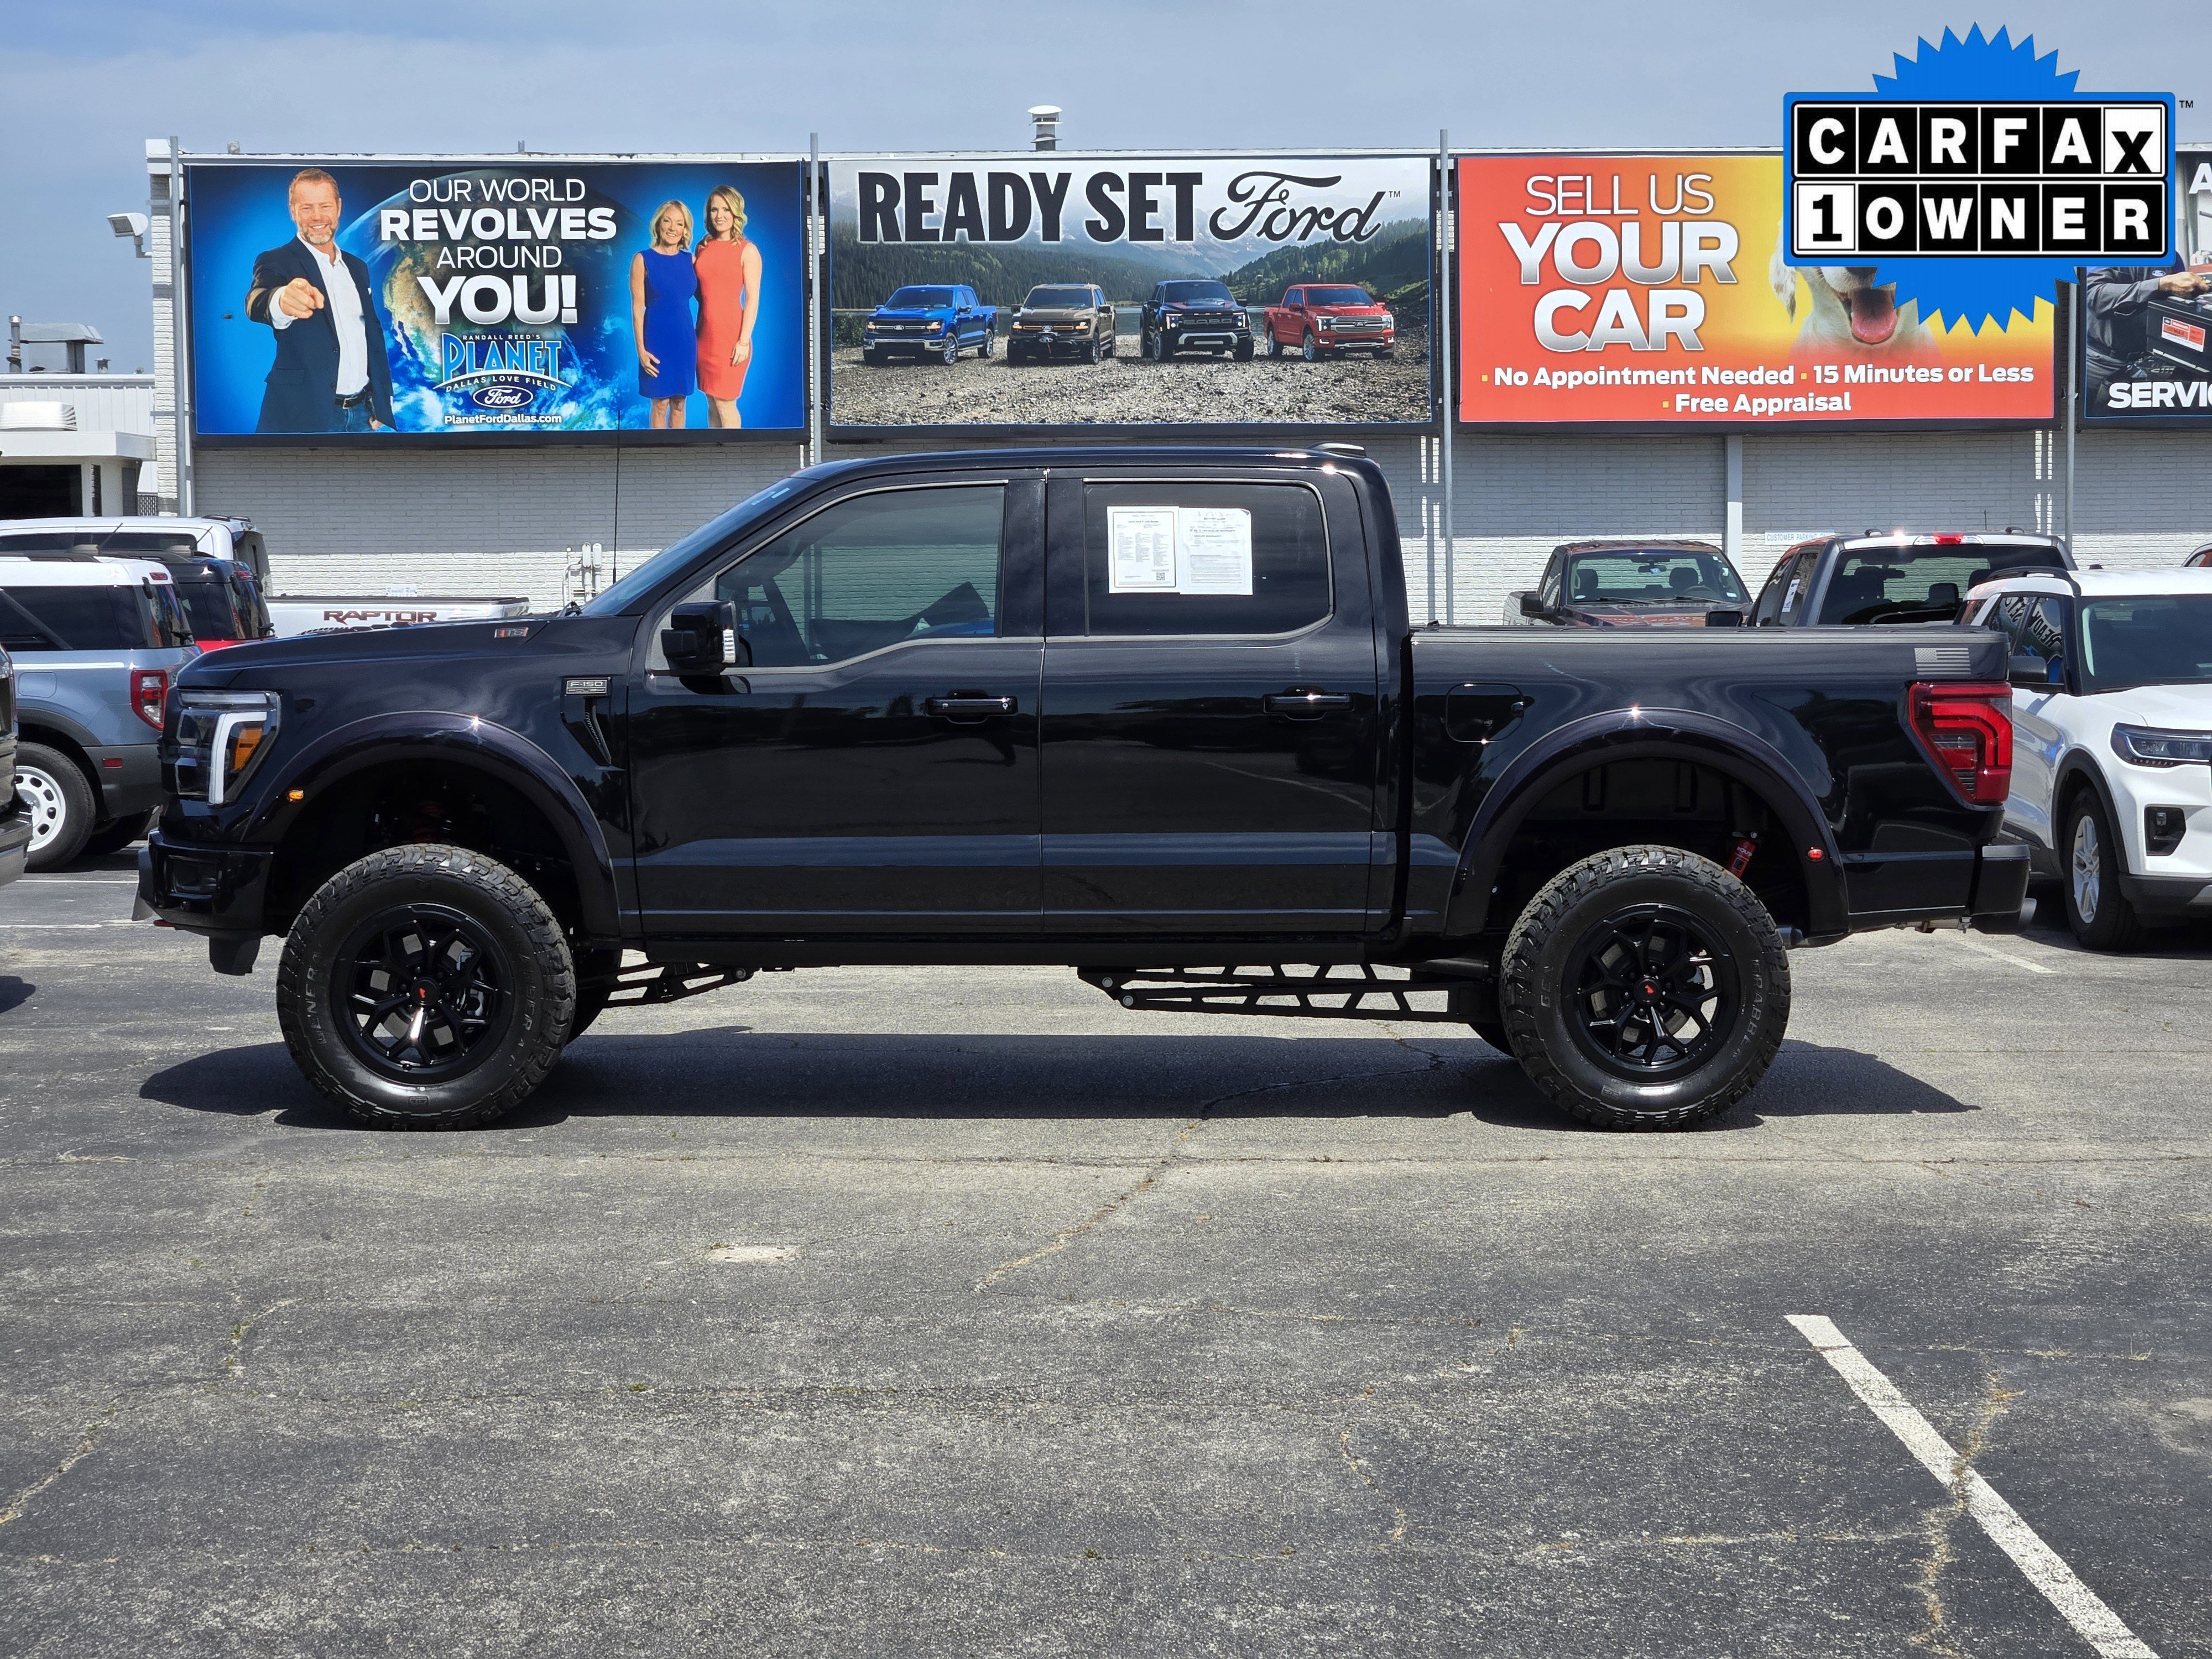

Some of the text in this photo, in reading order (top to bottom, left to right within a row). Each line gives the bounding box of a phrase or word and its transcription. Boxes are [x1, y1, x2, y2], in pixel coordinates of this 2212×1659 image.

[409, 179, 585, 202] OUR WORLD
[1526, 174, 1714, 216] SELL US
[858, 172, 1072, 242] READY
[1086, 172, 1203, 242] SET
[1209, 171, 1386, 242] Ford
[380, 207, 617, 240] REVOLVES
[436, 246, 561, 268] AROUND
[1498, 221, 1739, 285] YOUR
[416, 275, 577, 325] YOU!
[1534, 289, 1705, 352] CAR
[442, 332, 561, 383] PLANET
[446, 377, 486, 393] DALLAS
[526, 378, 556, 391] FIELD
[1494, 363, 2034, 389] No Appointment Needed 15 Minutes or Less
[484, 388, 521, 404] Ford
[1675, 392, 1851, 416] Free Appraisal
[2107, 382, 2212, 408] SERVI
[445, 414, 562, 424] PlanetFordDallas.com
[324, 611, 439, 625] RAPTOR
